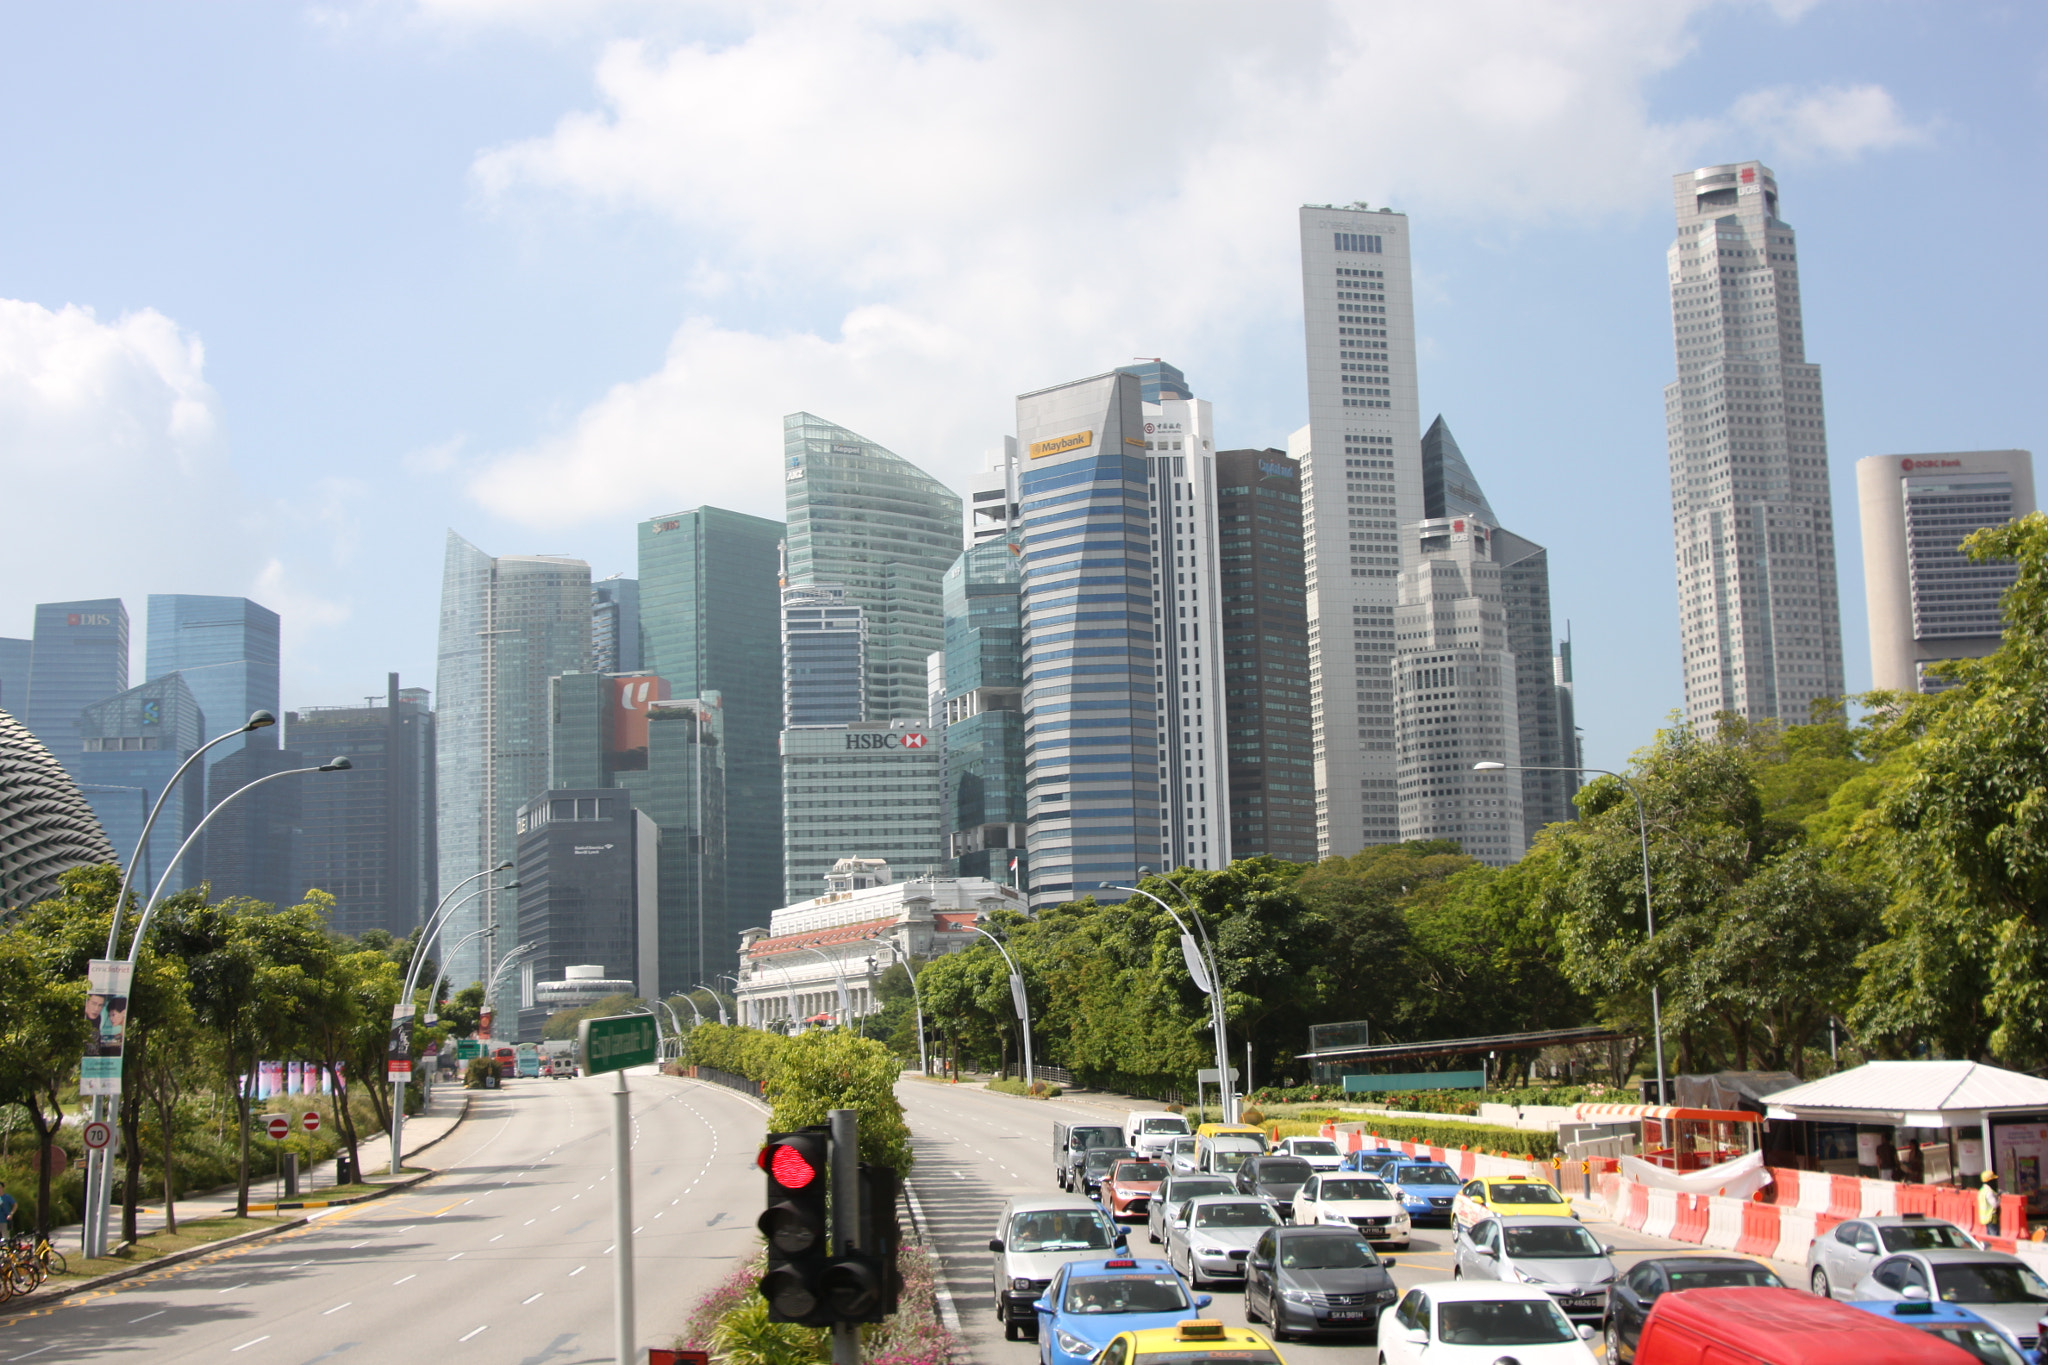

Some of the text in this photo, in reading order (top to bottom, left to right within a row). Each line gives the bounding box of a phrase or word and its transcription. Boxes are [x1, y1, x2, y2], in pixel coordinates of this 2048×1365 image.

[1738, 184, 1760, 195] UOB
[1041, 434, 1085, 453] Maybank
[80, 614, 110, 625] DBS
[846, 733, 898, 750] HSBC
[91, 1130, 103, 1141] 70
